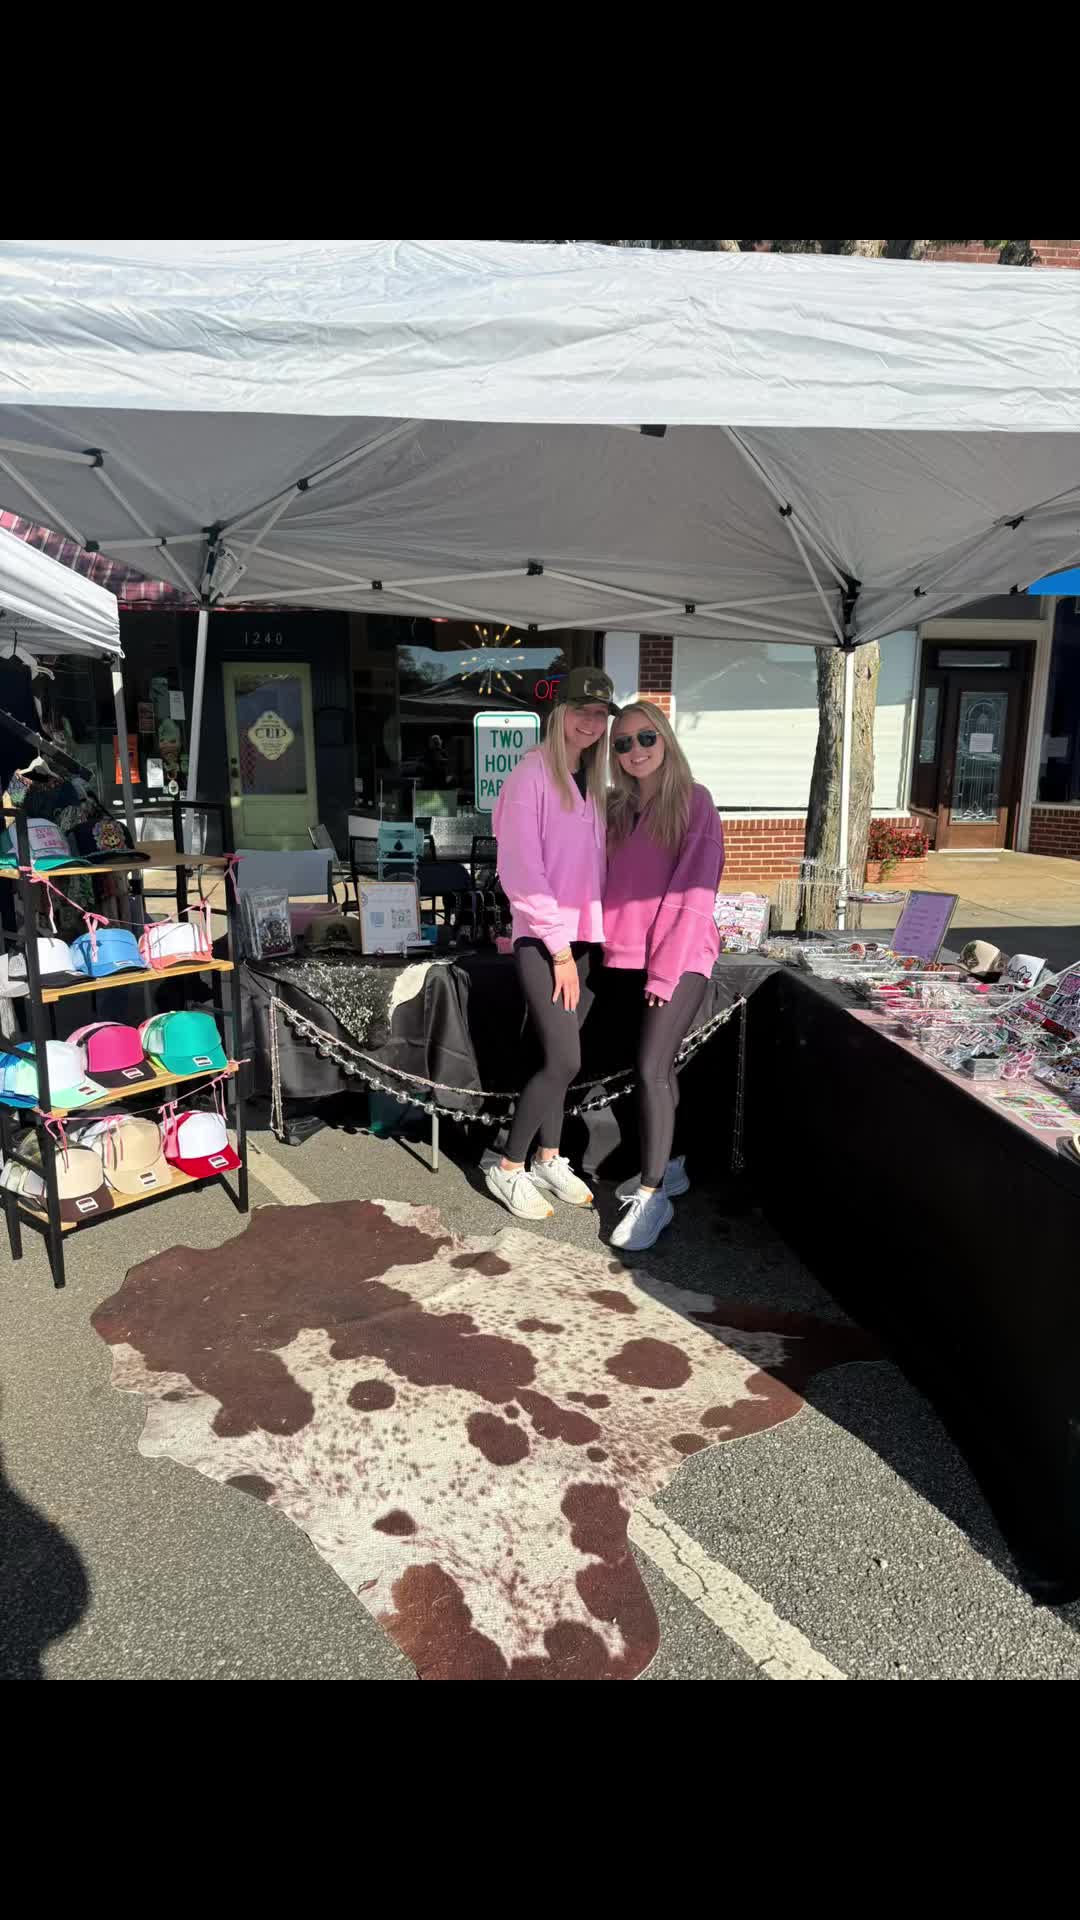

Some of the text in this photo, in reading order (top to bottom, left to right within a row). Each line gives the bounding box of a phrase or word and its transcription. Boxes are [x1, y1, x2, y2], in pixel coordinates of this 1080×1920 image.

[245, 631, 283, 646] 1240
[489, 729, 523, 748] TWO
[485, 754, 525, 773] HOU
